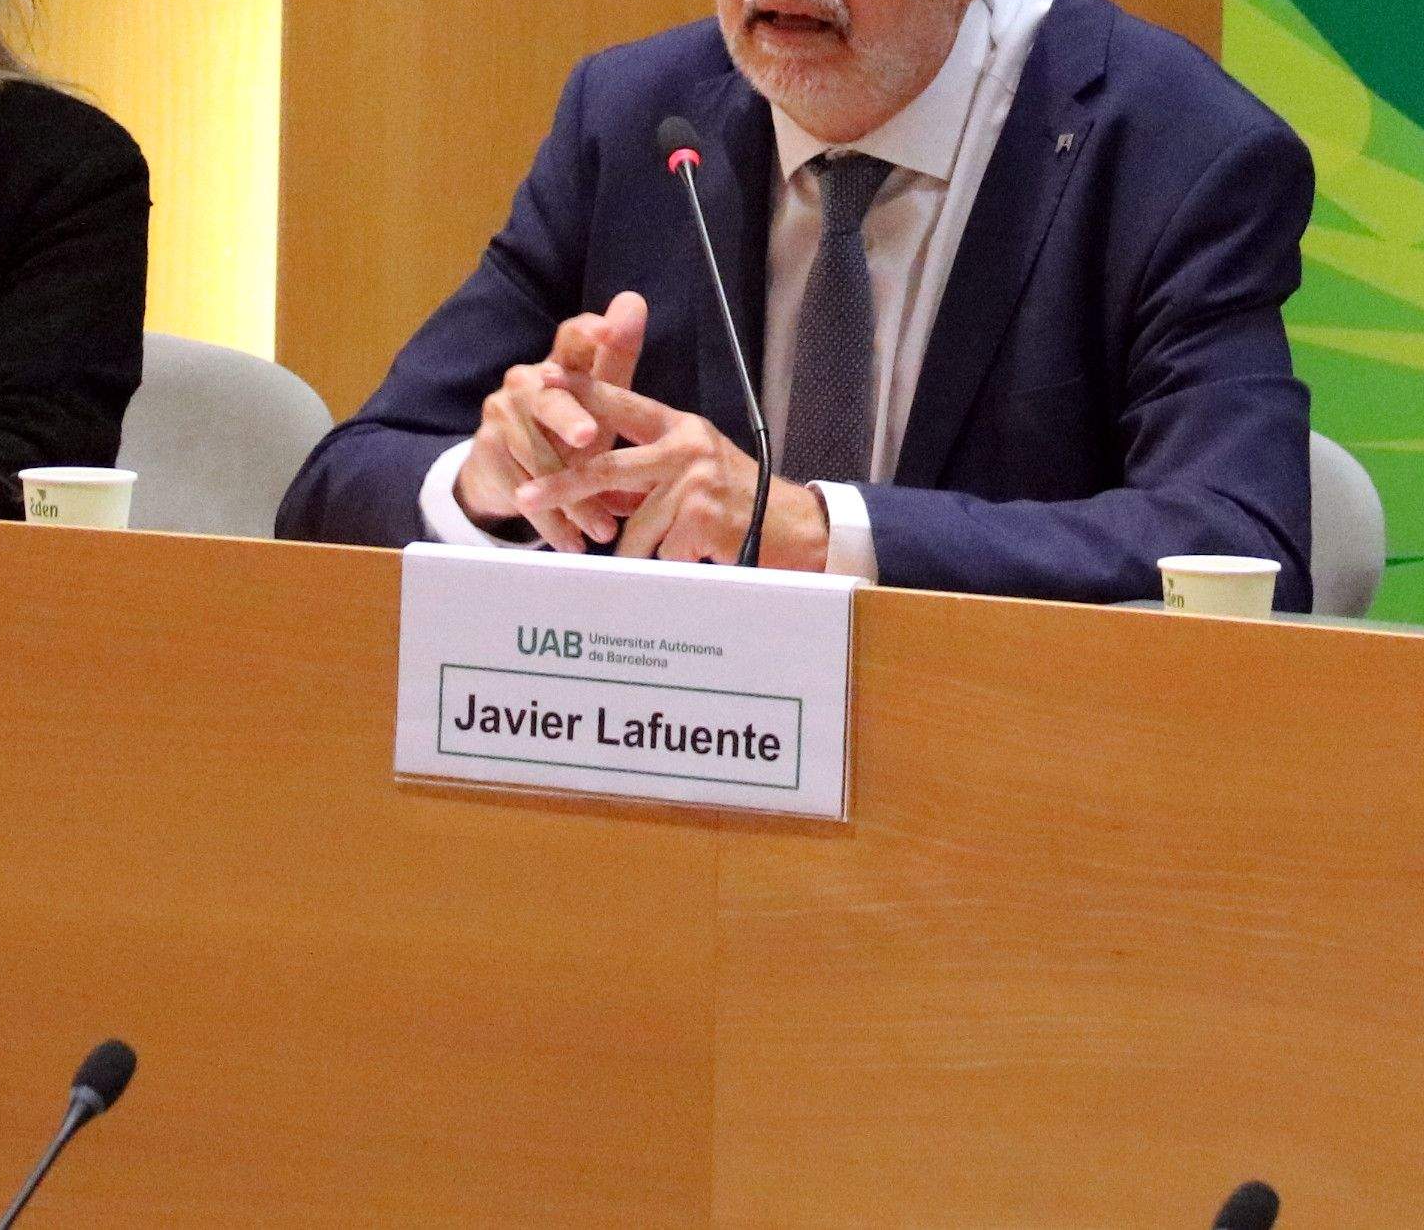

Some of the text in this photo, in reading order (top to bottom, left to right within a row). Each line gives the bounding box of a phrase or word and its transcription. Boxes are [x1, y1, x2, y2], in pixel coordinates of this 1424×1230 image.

[517, 625, 583, 659] UAB
[589, 632, 656, 651] Universitat
[588, 648, 669, 669] de Barcelona
[454, 694, 781, 761] Javier Lafuente
